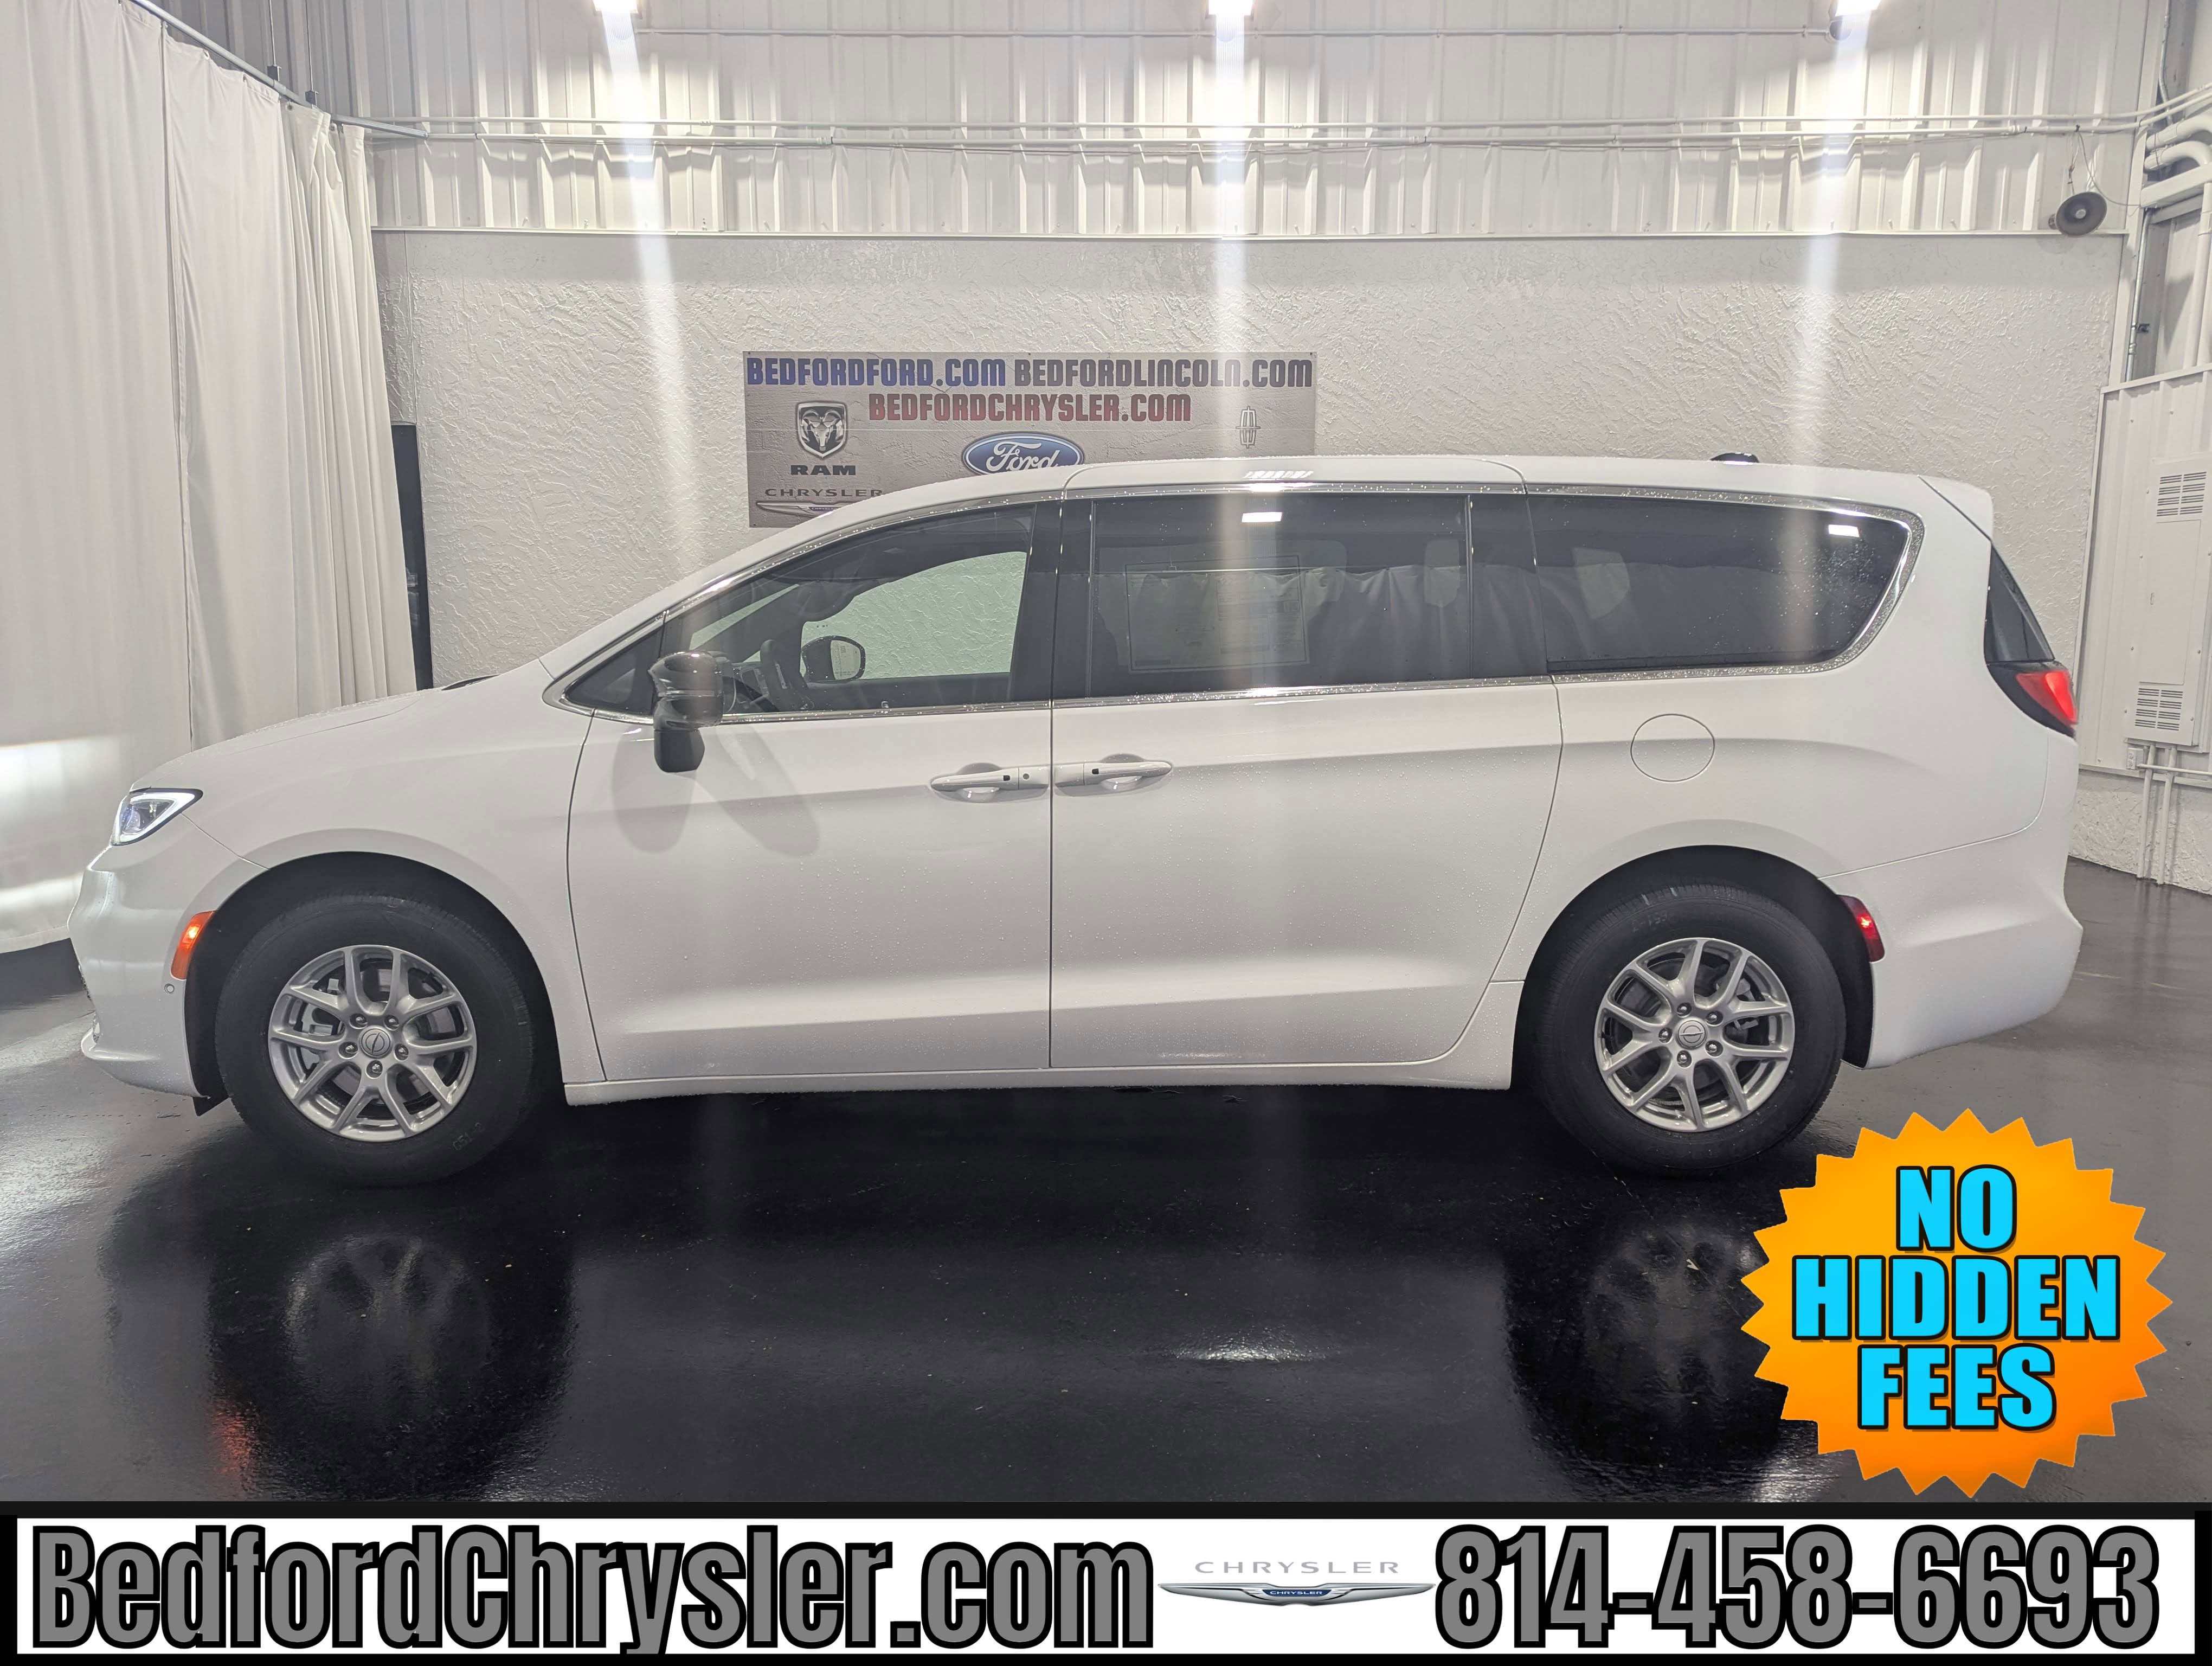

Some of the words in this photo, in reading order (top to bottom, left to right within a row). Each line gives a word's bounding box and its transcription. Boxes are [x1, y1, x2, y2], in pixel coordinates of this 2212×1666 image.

[747, 358, 1006, 387] BEDFORDFORD.COM
[1014, 359, 1313, 387] BEDFORDLINCOLN.COM
[869, 393, 1191, 421] BEDFORDCHRYSLER.COM
[790, 465, 856, 476] RAM
[986, 441, 1061, 472] Ford
[764, 489, 883, 497] CHRYSLER
